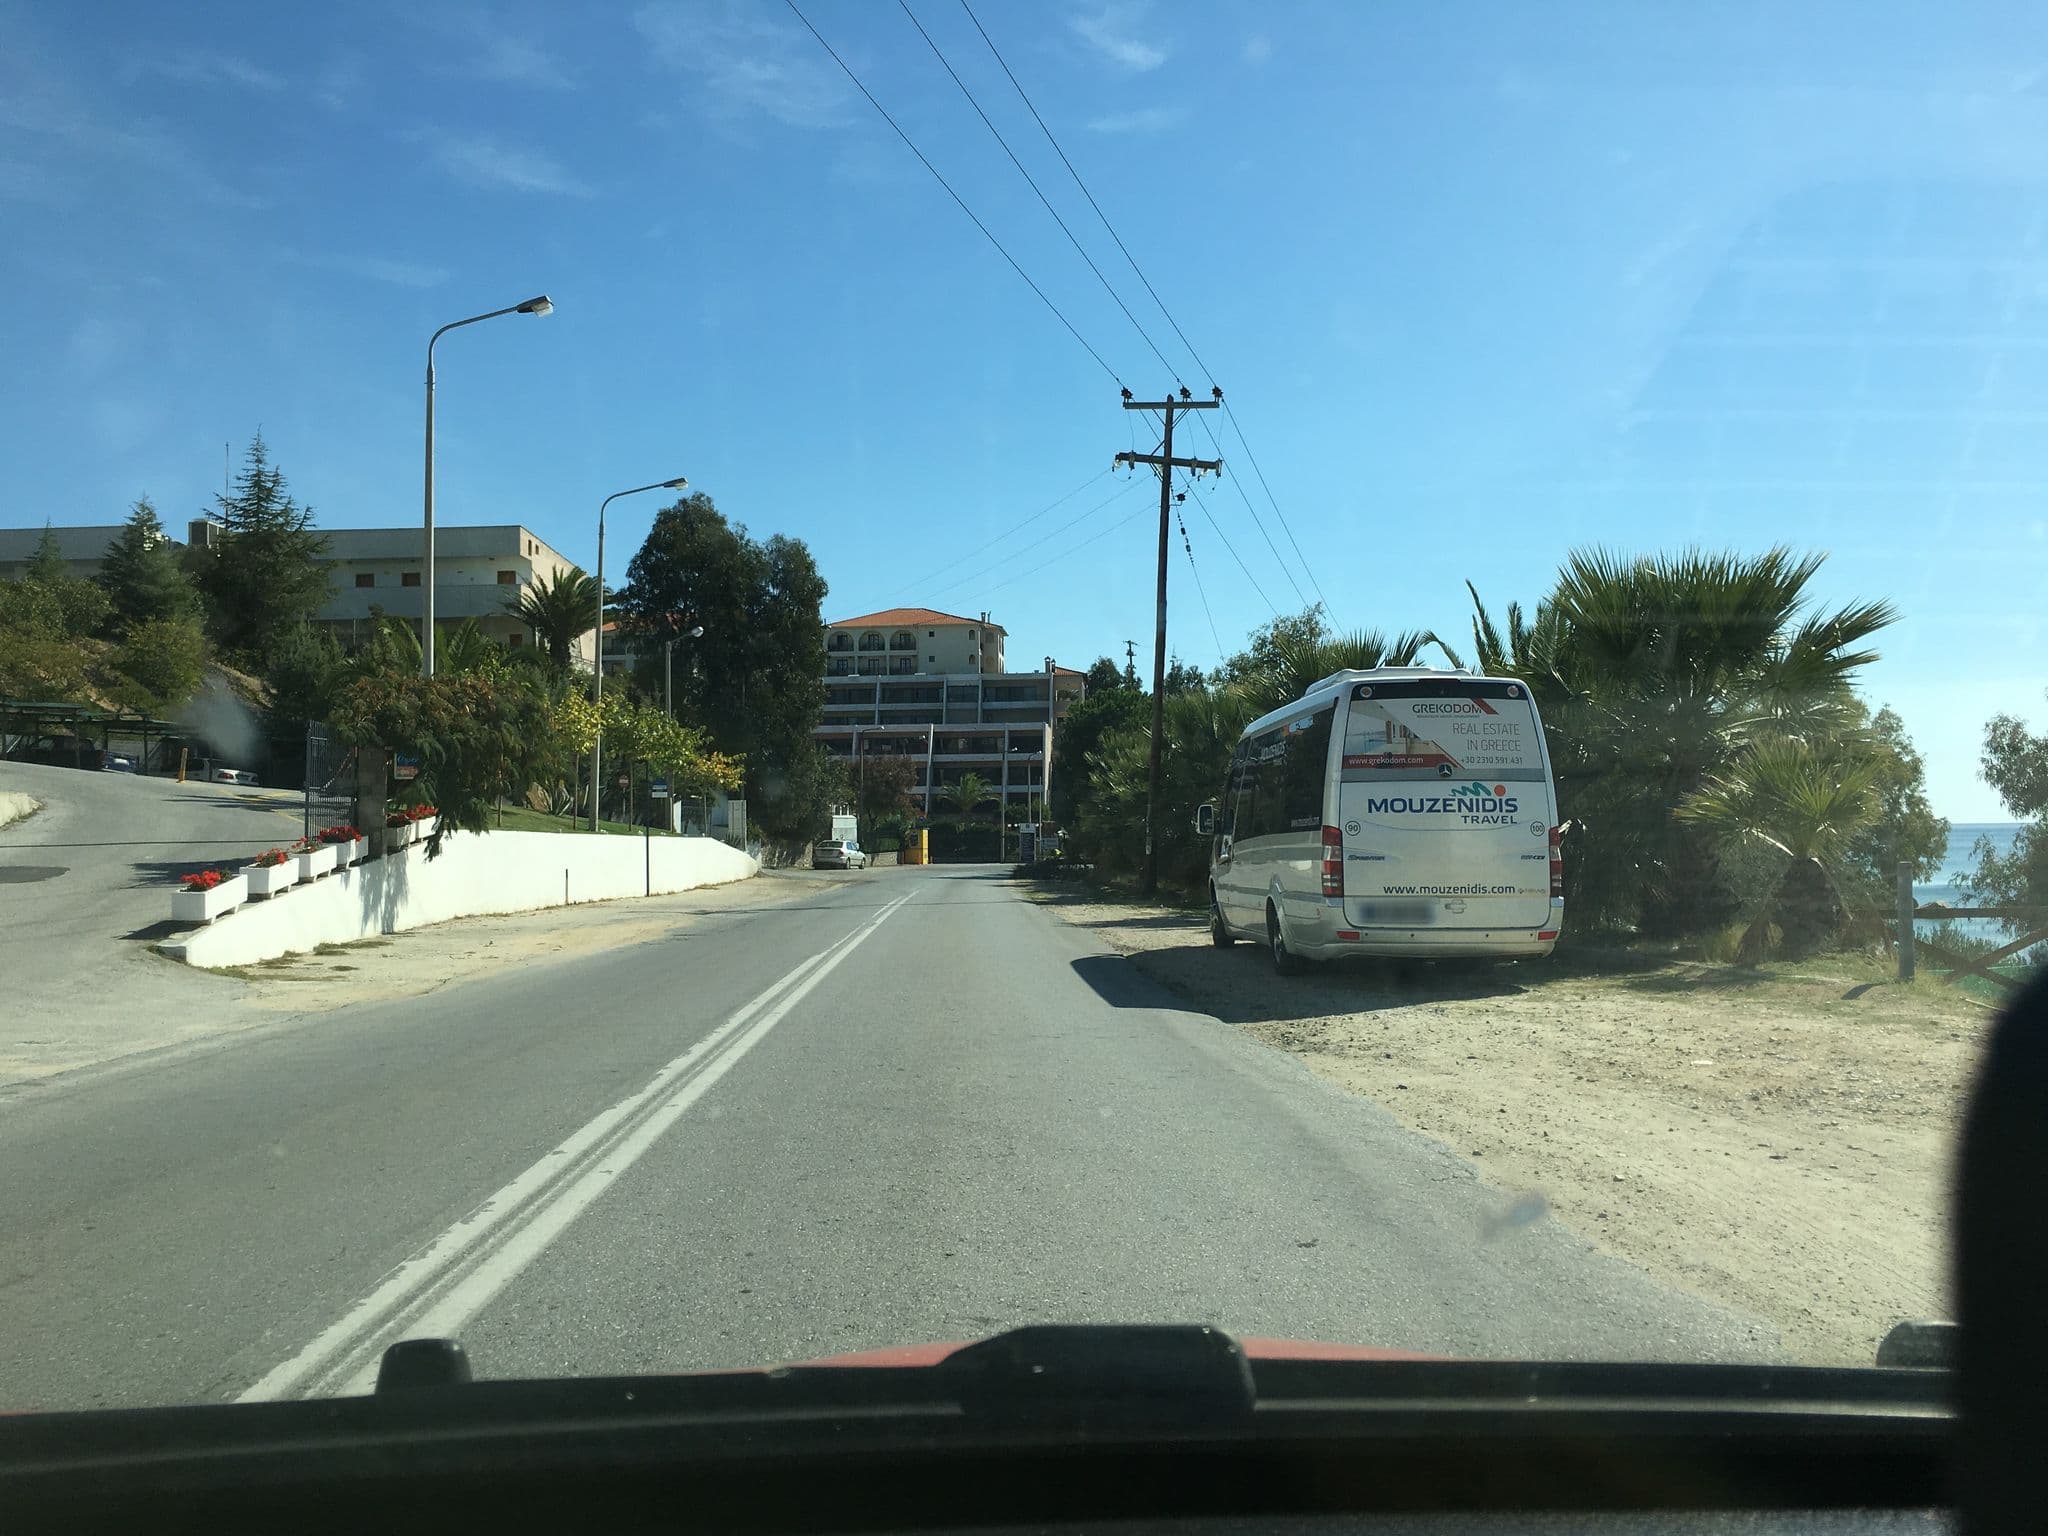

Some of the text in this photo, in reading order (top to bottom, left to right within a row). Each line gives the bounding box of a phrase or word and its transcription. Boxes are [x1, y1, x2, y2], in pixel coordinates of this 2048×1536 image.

[1412, 703, 1482, 714] GREKODOM
[1453, 723, 1521, 736] REAL ESTATE
[1467, 740, 1521, 752] IN GREECE
[1349, 757, 1424, 767] www.grekodom.com
[1476, 757, 1494, 765] 2310
[1367, 797, 1519, 814] MOUZENIDIS
[1461, 815, 1518, 825] TRAVEL
[1348, 824, 1359, 832] 90
[1531, 824, 1544, 833] 100
[1383, 884, 1515, 895] www.mouzenidis.com
